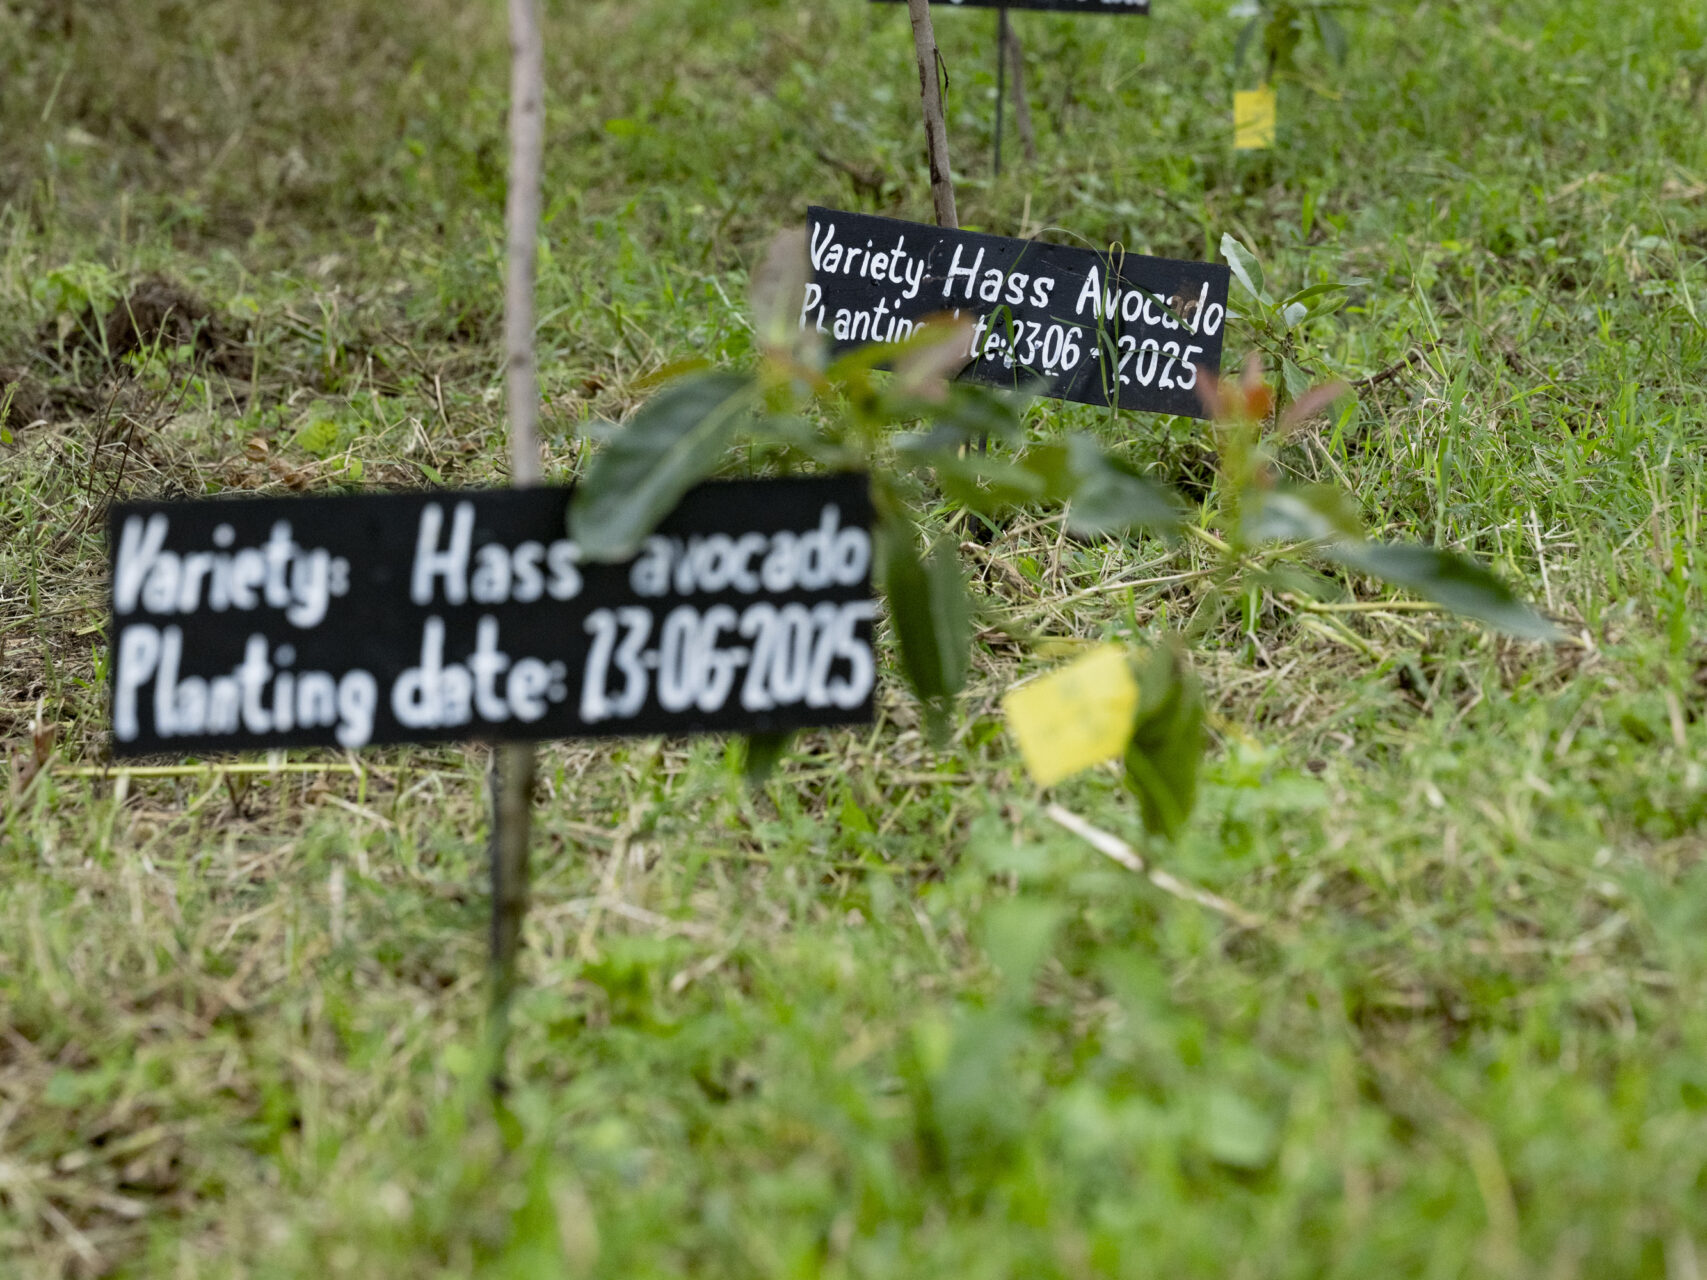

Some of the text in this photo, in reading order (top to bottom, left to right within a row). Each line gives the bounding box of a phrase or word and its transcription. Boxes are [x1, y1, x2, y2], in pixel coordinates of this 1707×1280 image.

[942, 243, 1056, 308] Hass
[1075, 264, 1225, 337] Avocado
[113, 499, 873, 629] Variety: Hass avocado
[113, 600, 880, 749] Planting date: 23-06-2025
